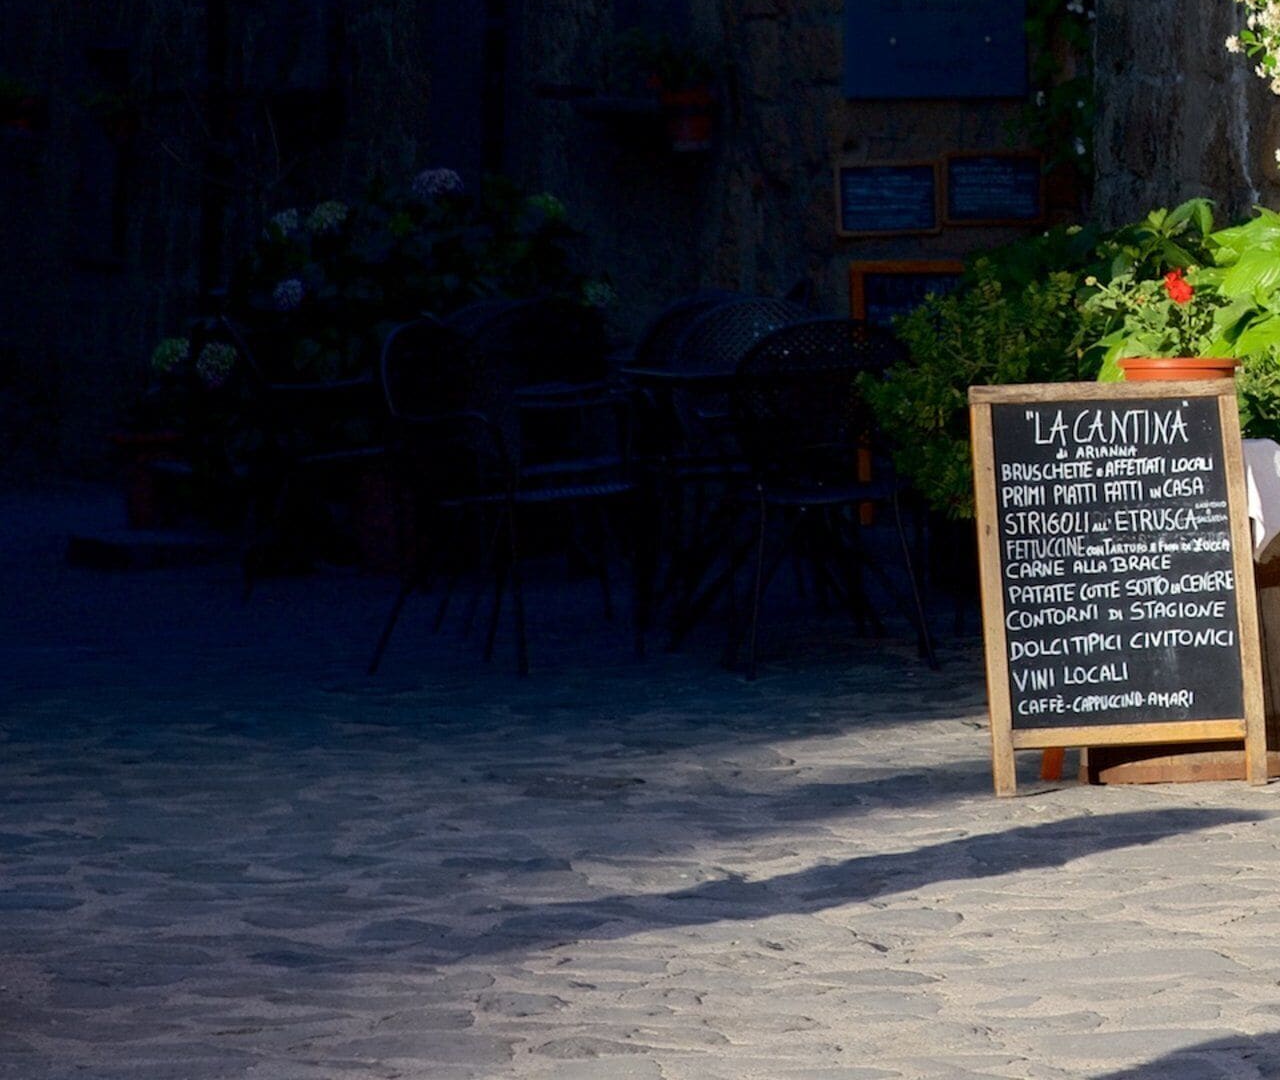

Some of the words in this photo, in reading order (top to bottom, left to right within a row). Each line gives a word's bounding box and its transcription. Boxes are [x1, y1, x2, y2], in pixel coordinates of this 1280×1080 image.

[1076, 445, 1138, 459] ARIANNA
[1002, 461, 1093, 481] BRUSCHETTE
[1105, 457, 1166, 477] AFFETTATI
[1172, 457, 1213, 472] LOCALI
[1003, 485, 1045, 507] PRIMI
[1054, 483, 1097, 505] PIATTI
[1104, 480, 1143, 503] FATTI
[1163, 477, 1204, 497] CASA
[1005, 511, 1089, 536] STRIGOLI
[1006, 535, 1086, 560] FETTUCCINE
[1006, 559, 1065, 579] CARNE
[1073, 559, 1107, 574] ALLA
[1110, 555, 1171, 572] BRACE
[1008, 584, 1076, 604] PATATE
[1080, 581, 1120, 601] COTTE
[1125, 575, 1169, 597] SOTTO
[1180, 570, 1234, 593] CENERE
[1006, 605, 1098, 631] CONTORNI
[1108, 609, 1123, 621] DI
[1130, 600, 1226, 621] STAGIONE
[1010, 634, 1068, 661] DOLCI
[1071, 632, 1121, 656] TIPICI
[1130, 628, 1233, 649] CIVITONICI
[1013, 668, 1055, 692] VINI
[1064, 662, 1128, 685] LOCALI
